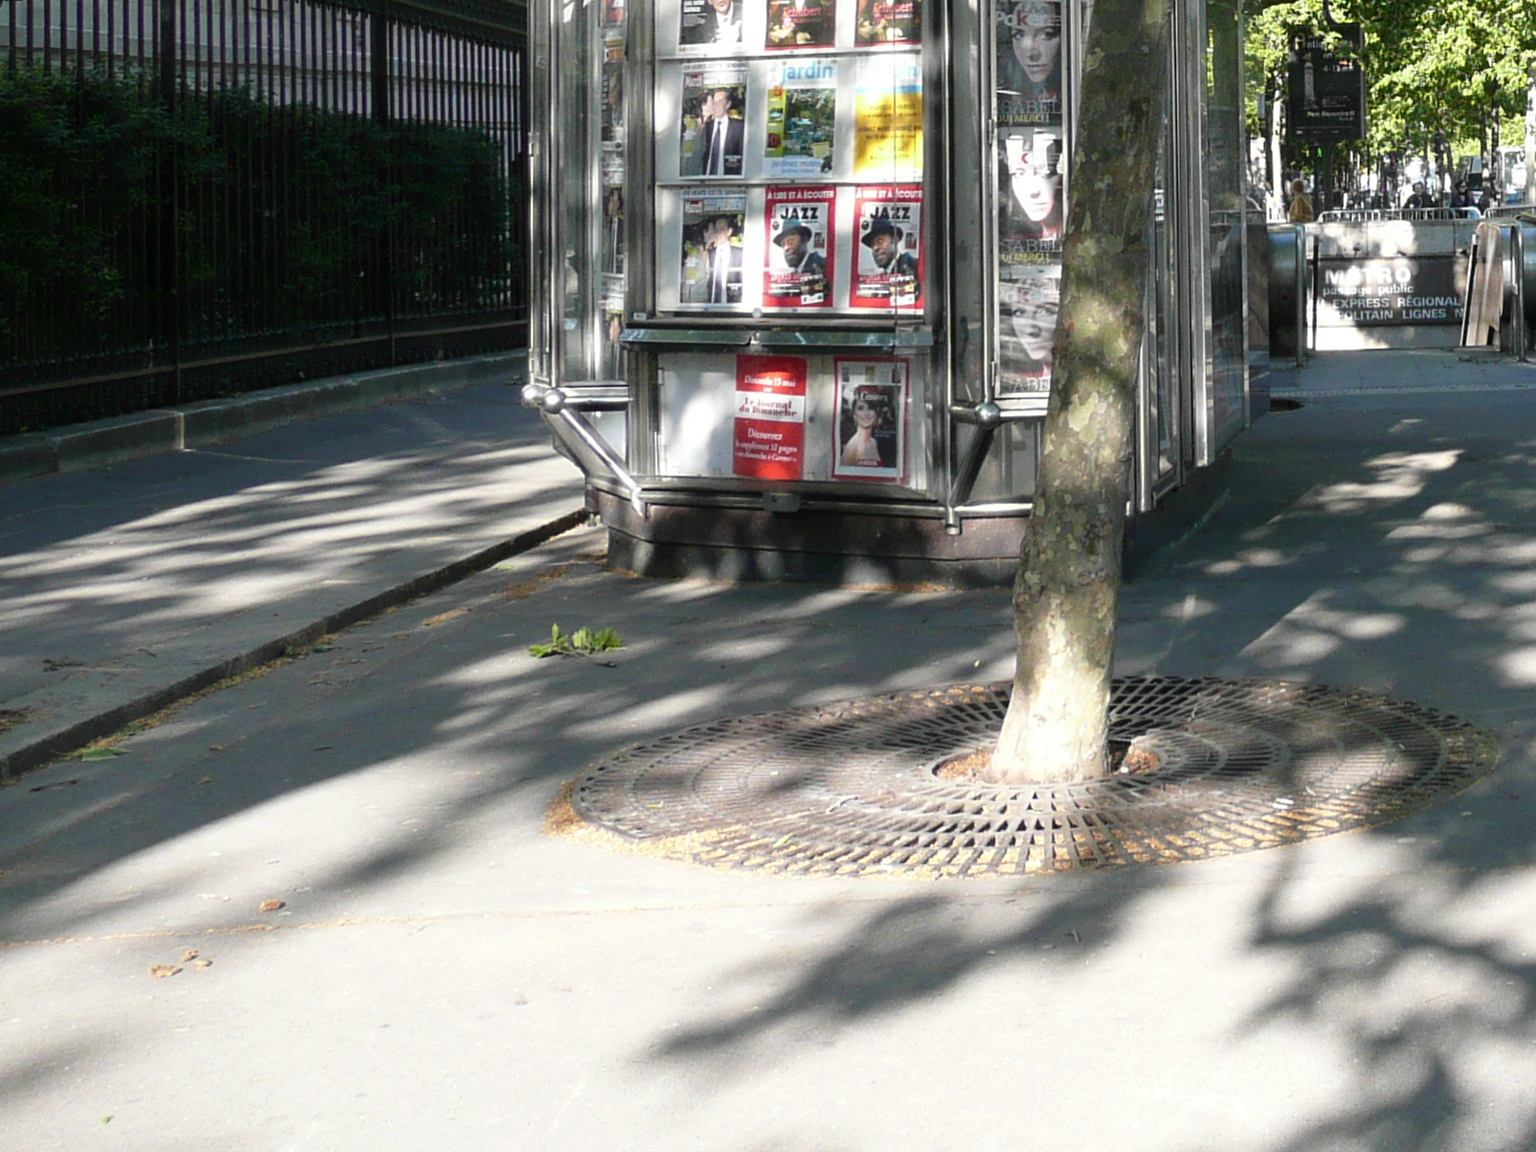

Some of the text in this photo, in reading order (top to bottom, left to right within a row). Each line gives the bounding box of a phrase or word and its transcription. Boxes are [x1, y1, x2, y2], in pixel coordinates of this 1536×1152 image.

[781, 61, 833, 85] jardin
[1001, 100, 1062, 114] SABEL
[780, 207, 819, 220] JAZZ
[870, 206, 911, 220] JAZZ
[1377, 283, 1414, 296] public
[1333, 295, 1461, 309] EXPRESS RÉGIONAL
[1338, 310, 1394, 321] POLITAIN
[1402, 308, 1447, 320] LIGNES
[744, 397, 792, 409] Le Journal
[739, 405, 798, 417] du Dimanche
